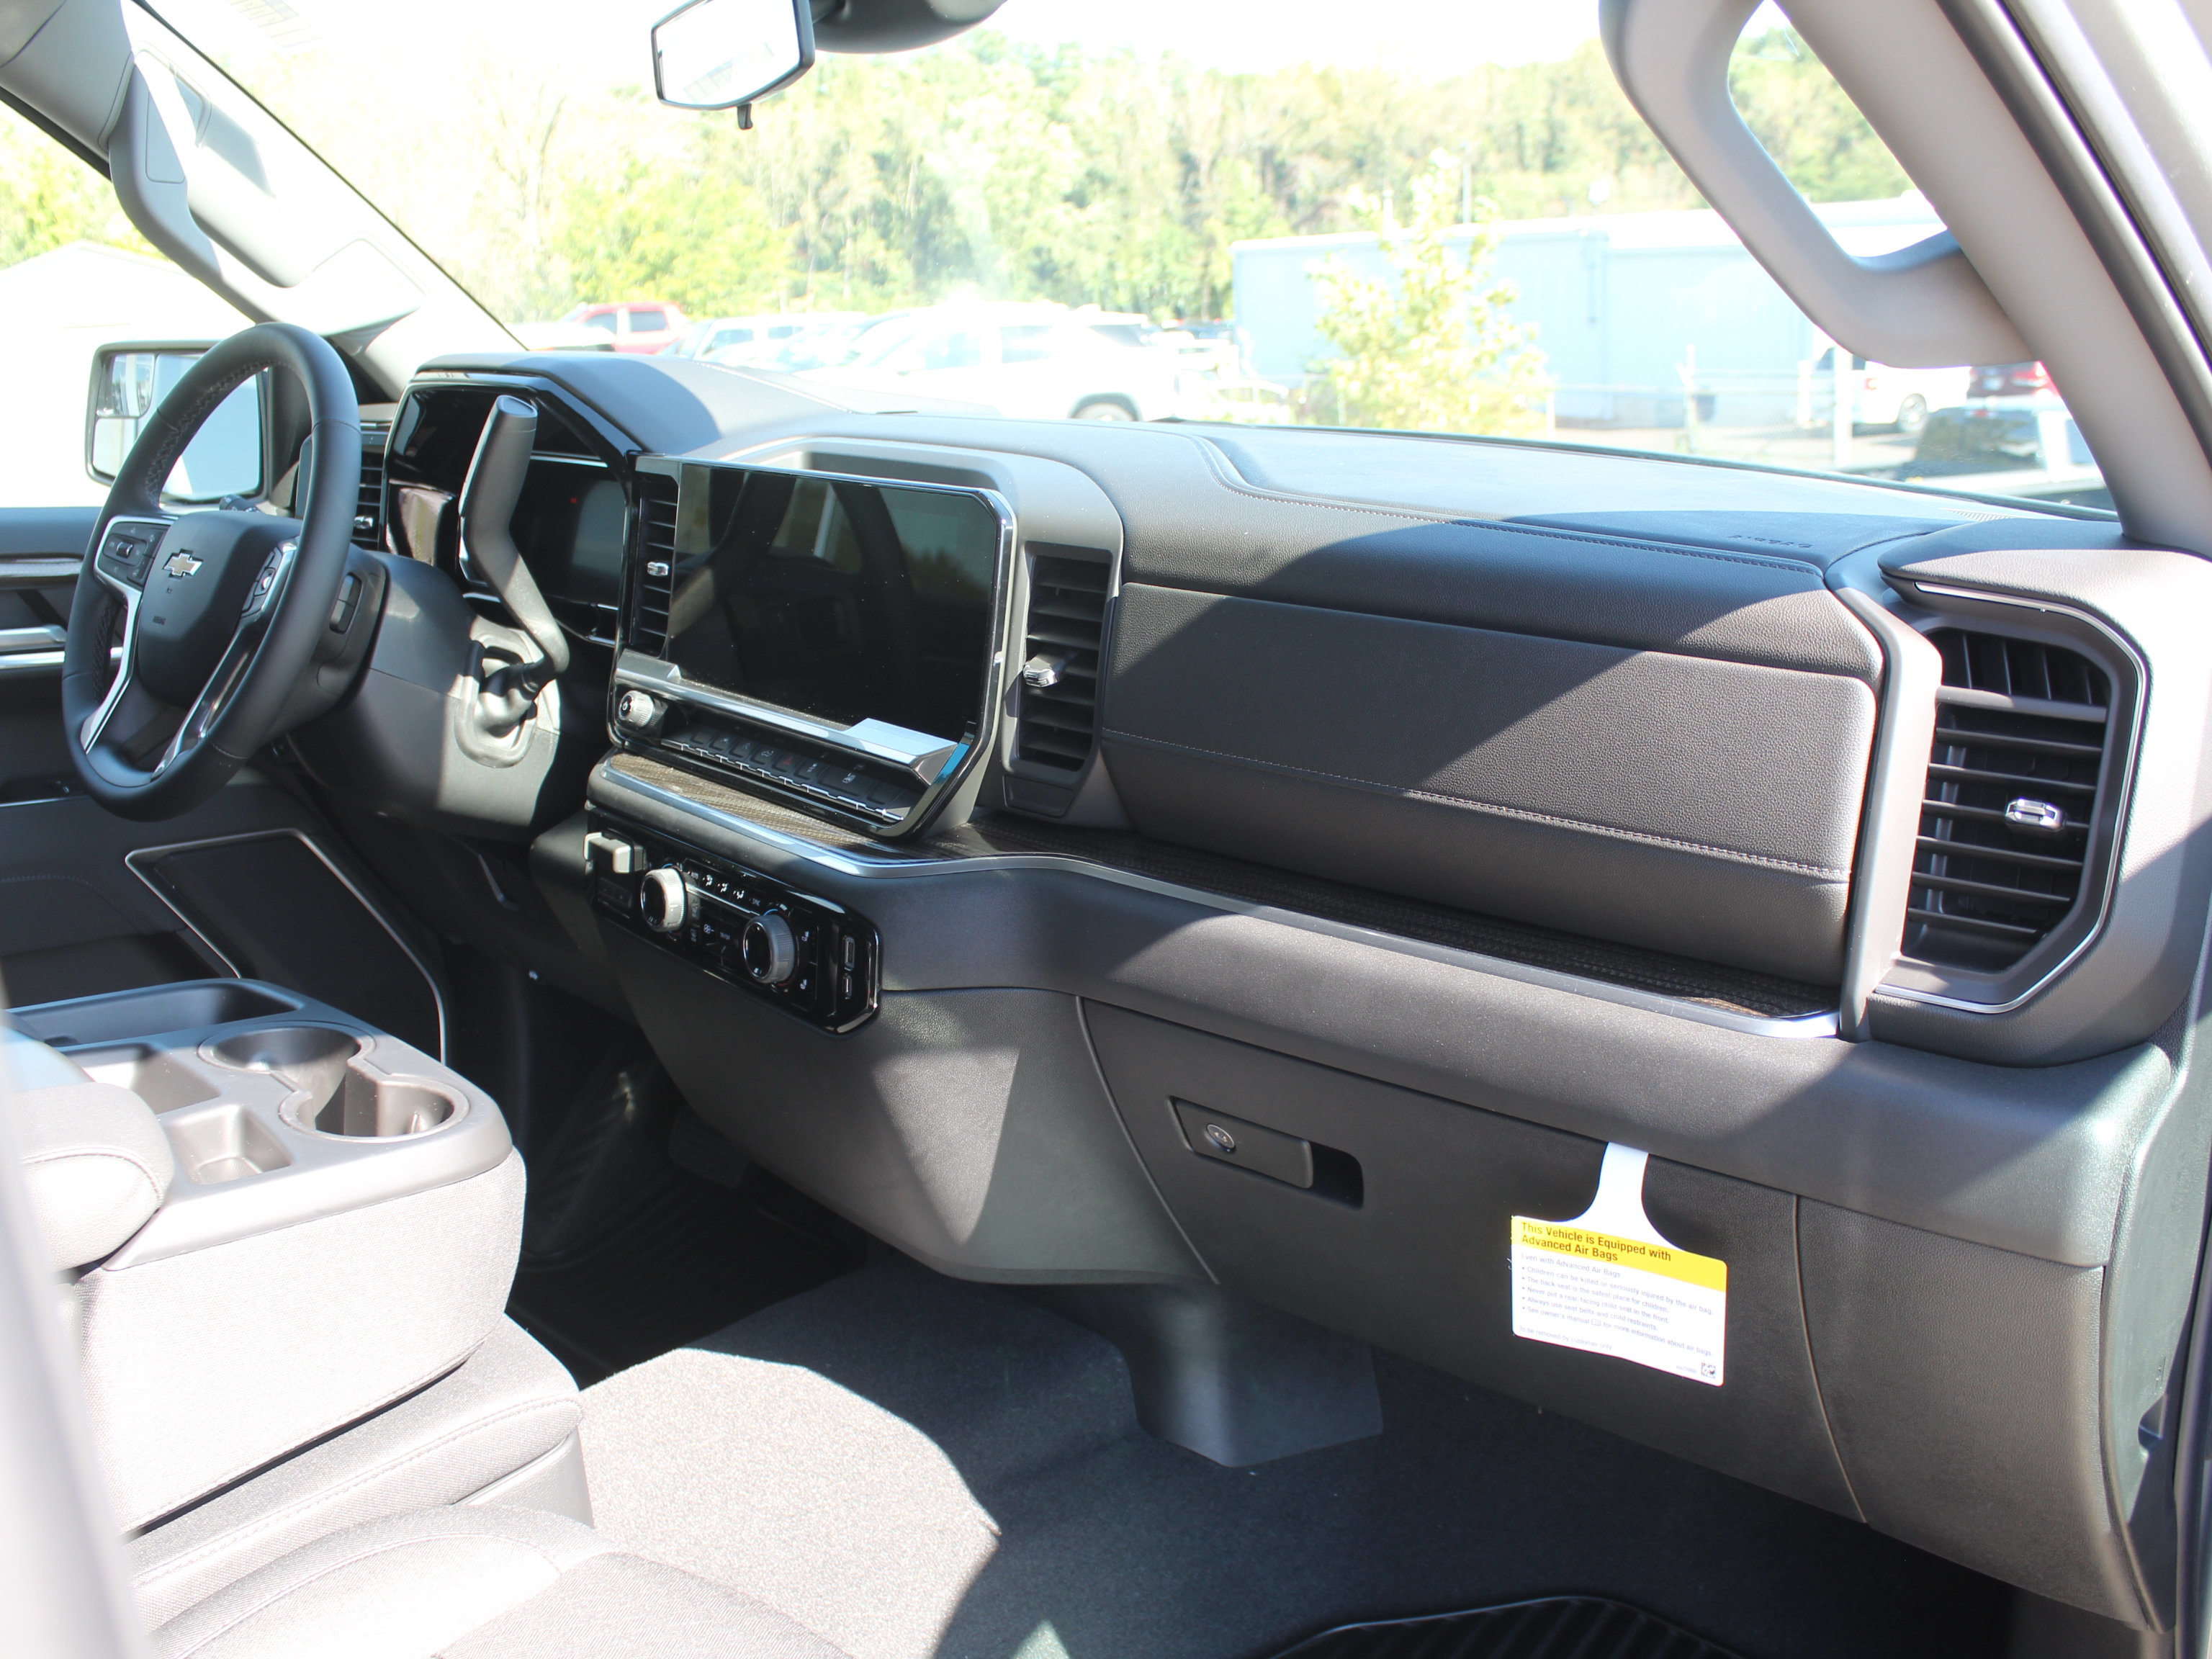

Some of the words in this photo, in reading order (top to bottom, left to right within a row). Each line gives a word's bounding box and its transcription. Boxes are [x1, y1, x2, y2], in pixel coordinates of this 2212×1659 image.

[1728, 535, 1813, 548] AIRBAG
[1522, 1223, 1542, 1233] This
[1546, 1227, 1582, 1242] Vehicle
[1586, 1235, 1594, 1244] is
[1598, 1237, 1645, 1254] Equipped
[1648, 1250, 1671, 1261] with
[1522, 1235, 1570, 1251] Advanced
[1574, 1245, 1588, 1255] Air
[1592, 1248, 1617, 1262] Bags
[1556, 1259, 1589, 1272] Advanced
[1604, 1269, 1620, 1278] Bags
[1527, 1266, 1554, 1276] Children
[1610, 1283, 1638, 1295] seriously
[1641, 1289, 1663, 1300] injured
[1665, 1296, 1673, 1305] by
[1527, 1286, 1545, 1295] Never
[1565, 1295, 1599, 1306] rear-facing
[1527, 1296, 1549, 1305] Always
[1627, 1318, 1658, 1330] restraints.
[1642, 1301, 1668, 1312] children.
[1541, 1310, 1565, 1318] owner's
[1631, 1328, 1665, 1343] information
[1667, 1339, 1684, 1348] about
